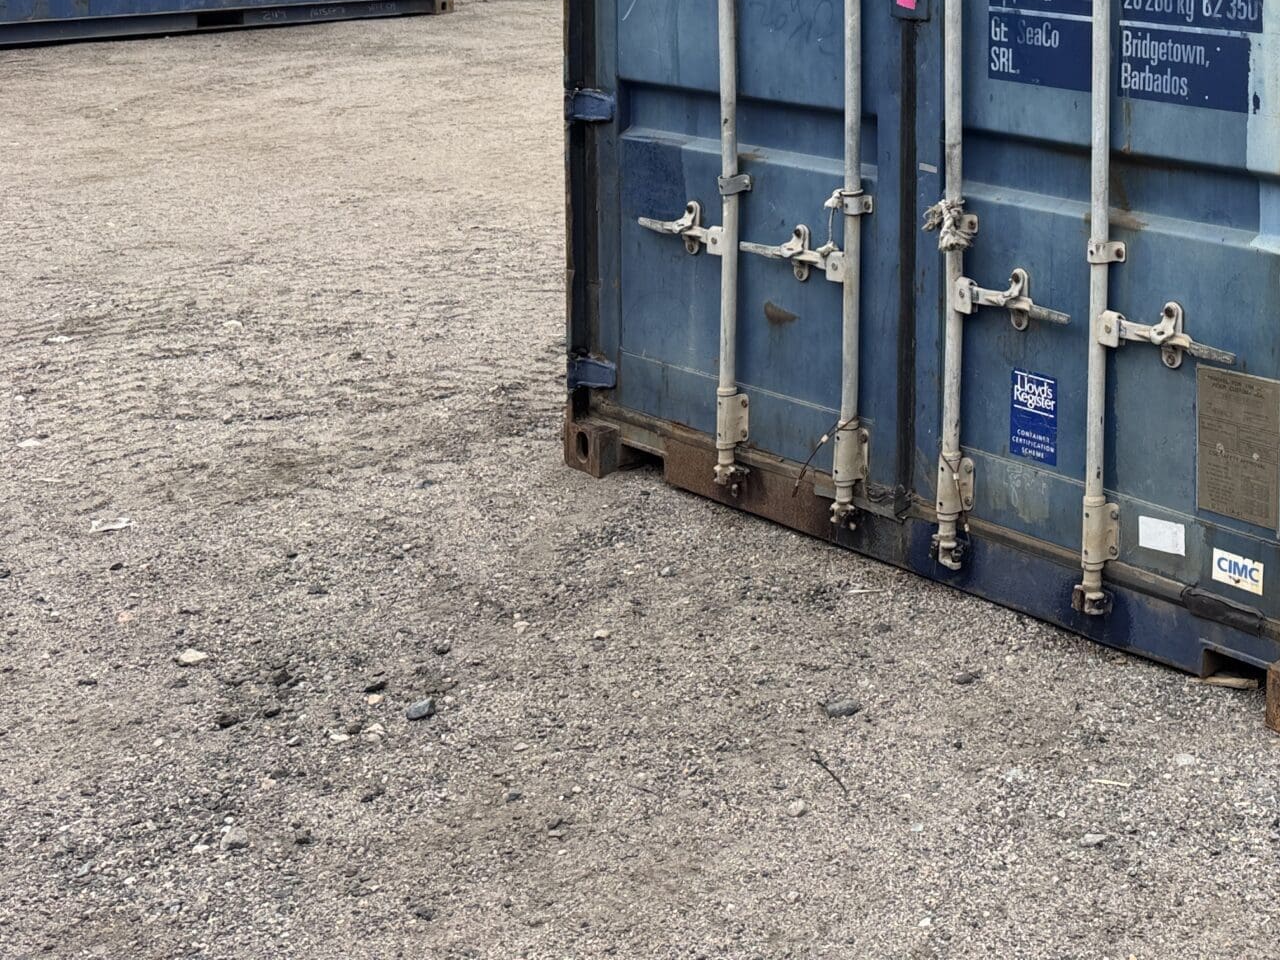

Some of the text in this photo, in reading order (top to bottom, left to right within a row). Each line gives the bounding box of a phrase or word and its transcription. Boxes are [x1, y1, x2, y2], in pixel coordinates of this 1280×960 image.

[1016, 19, 1060, 48] SeaCo
[1122, 29, 1210, 69] Bridgetown,
[1120, 62, 1188, 97] Barbados
[1013, 384, 1056, 411] Register
[1017, 374, 1053, 399] Lloyd's
[1011, 435, 1055, 453] CERTIFICATION
[1021, 446, 1045, 459] SCHEME
[1216, 556, 1260, 584] CIMC
